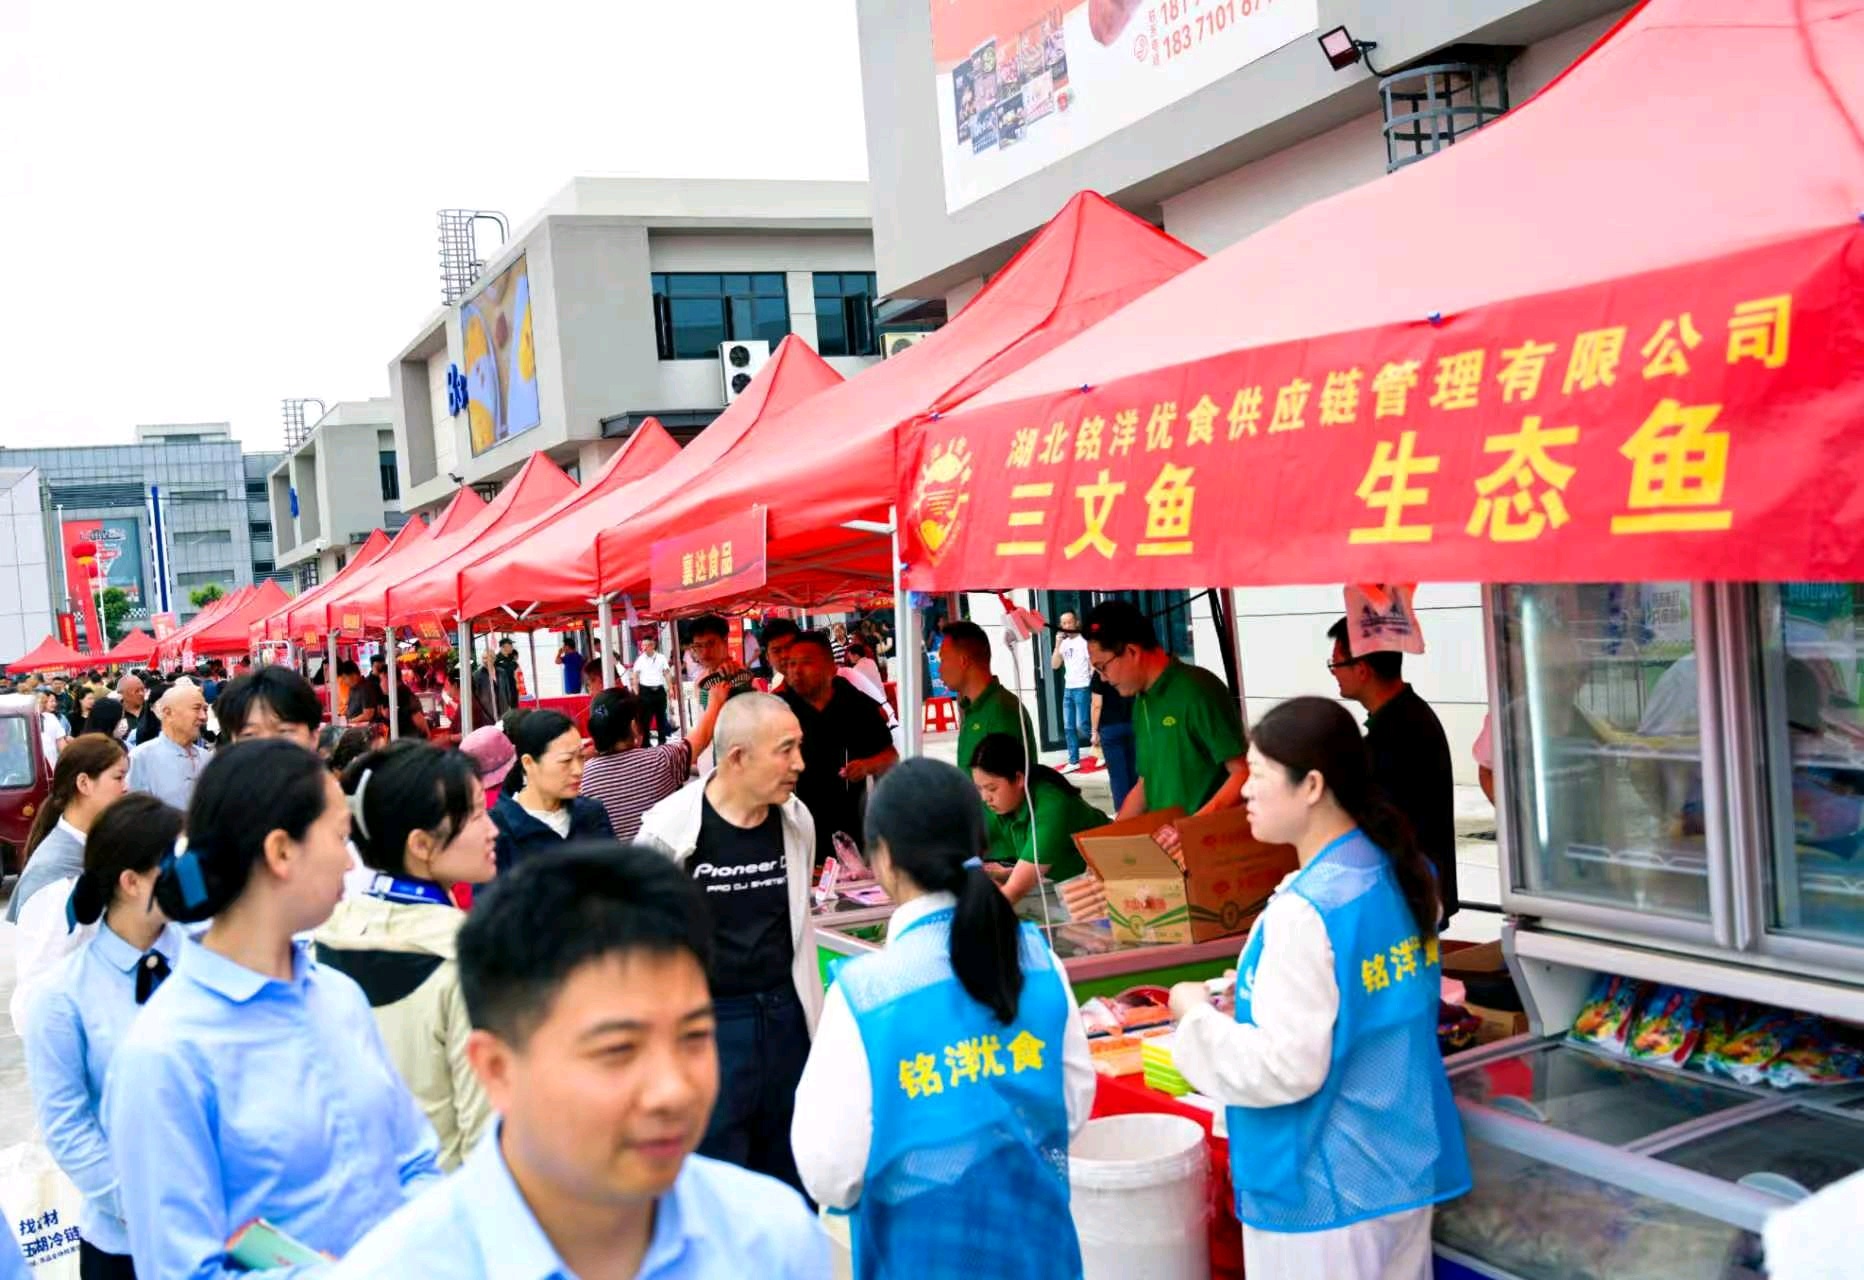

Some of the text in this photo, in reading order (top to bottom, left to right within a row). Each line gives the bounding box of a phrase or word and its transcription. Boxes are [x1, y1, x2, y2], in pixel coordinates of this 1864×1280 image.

[1162, 24, 1192, 59] 183
[1195, 0, 1236, 41] 7101
[1006, 294, 1793, 468] 湖北铭洋优食供应链管理有限公司
[996, 398, 1734, 560] 三文鱼 生态鱼
[692, 861, 778, 879] Pioneer
[706, 876, 788, 893] PRO DJ SYSTE
[899, 1030, 1046, 1099] 铭洋优食
[19, 1209, 58, 1236] 找材
